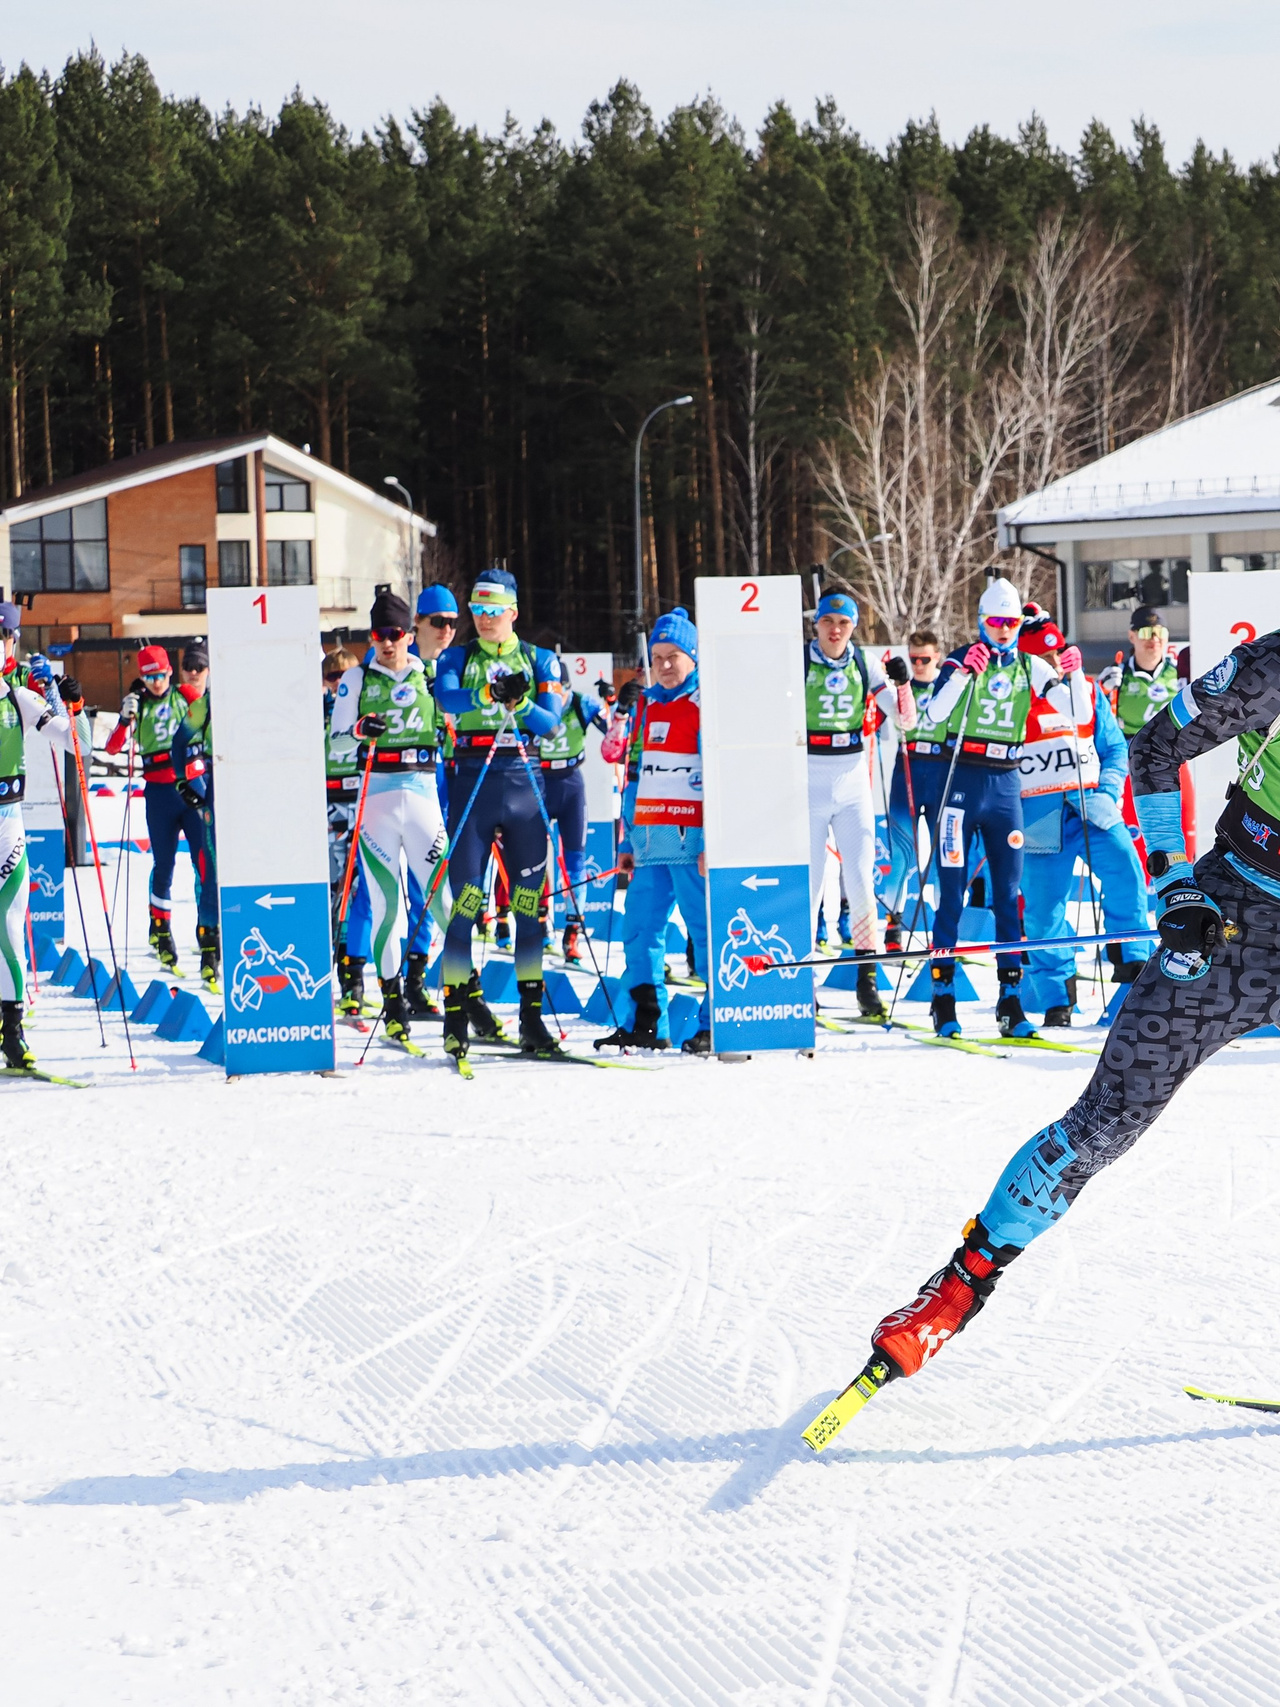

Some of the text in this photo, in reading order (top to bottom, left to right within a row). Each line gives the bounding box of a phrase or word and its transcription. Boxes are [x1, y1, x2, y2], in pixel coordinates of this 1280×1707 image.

[252, 594, 268, 625] 1
[740, 583, 759, 612] 2
[575, 657, 587, 675] 3
[818, 695, 854, 719] 35
[977, 699, 1014, 728] 31
[386, 707, 424, 735] 34
[714, 1004, 814, 1024] КРАСНОЯРСК
[226, 1024, 332, 1045] КРАСНОЯРСК
[953, 1260, 972, 1281] alpina
